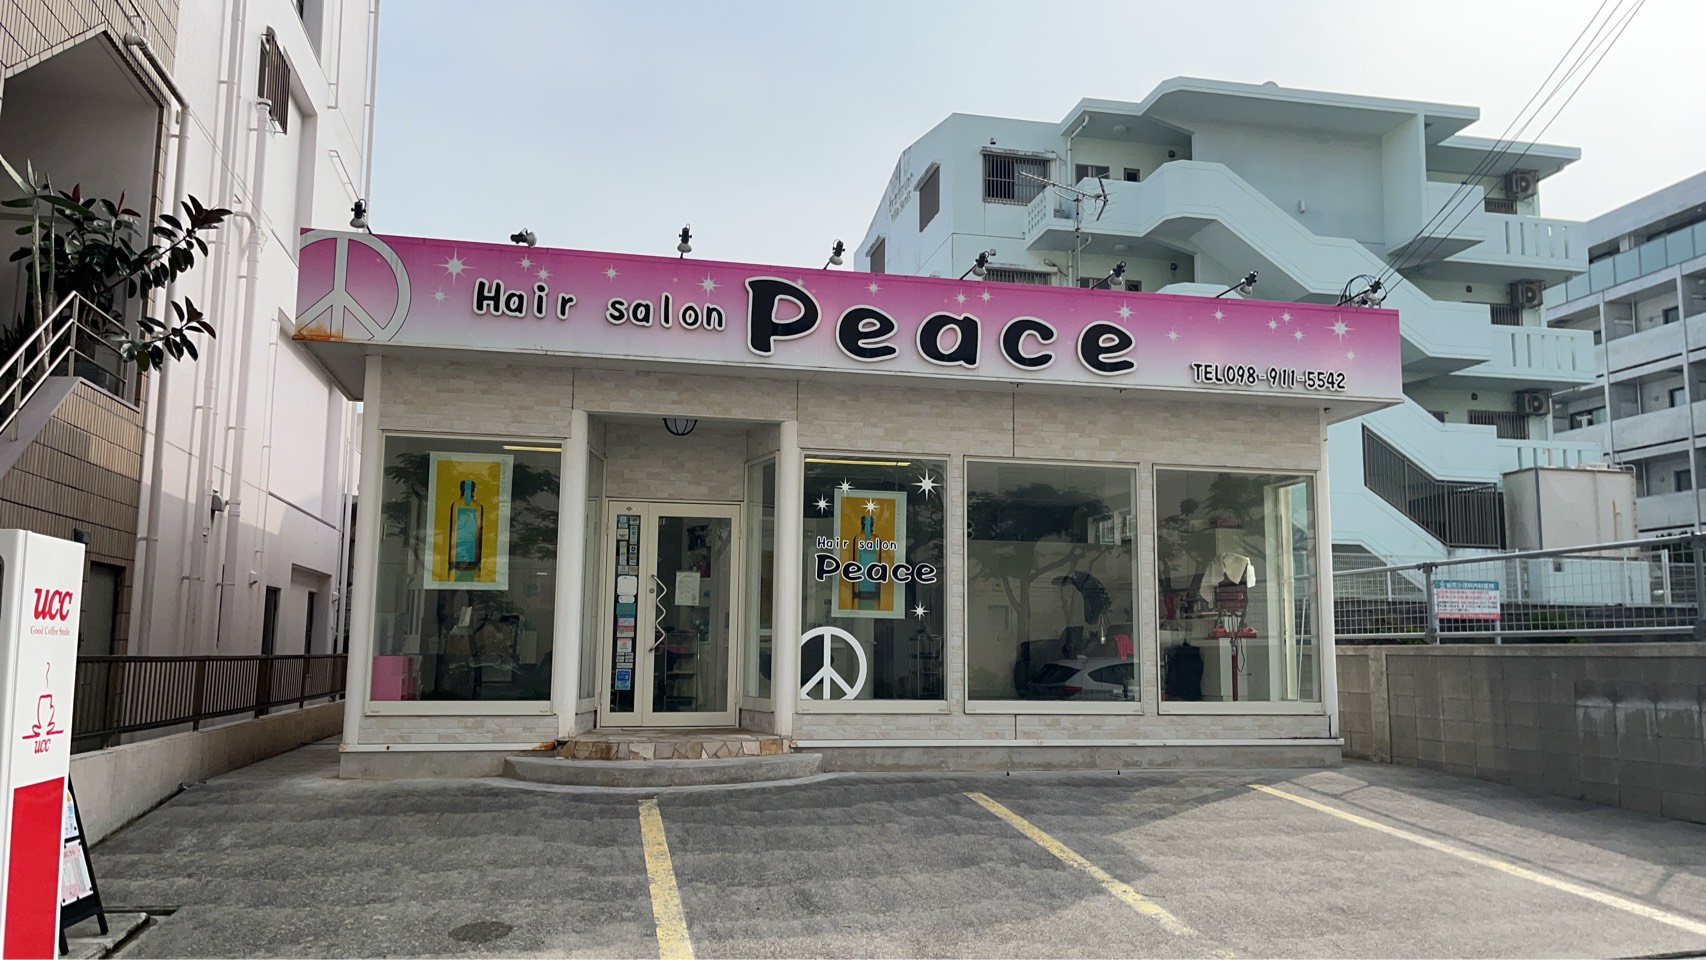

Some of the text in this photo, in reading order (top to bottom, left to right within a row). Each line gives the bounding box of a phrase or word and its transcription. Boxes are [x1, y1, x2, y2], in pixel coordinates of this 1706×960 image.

[473, 276, 1137, 375] Hair salon Peace
[817, 536, 897, 550] Hair salon
[815, 552, 937, 584] Peace
[30, 625, 71, 636] Good Coffee Smile
